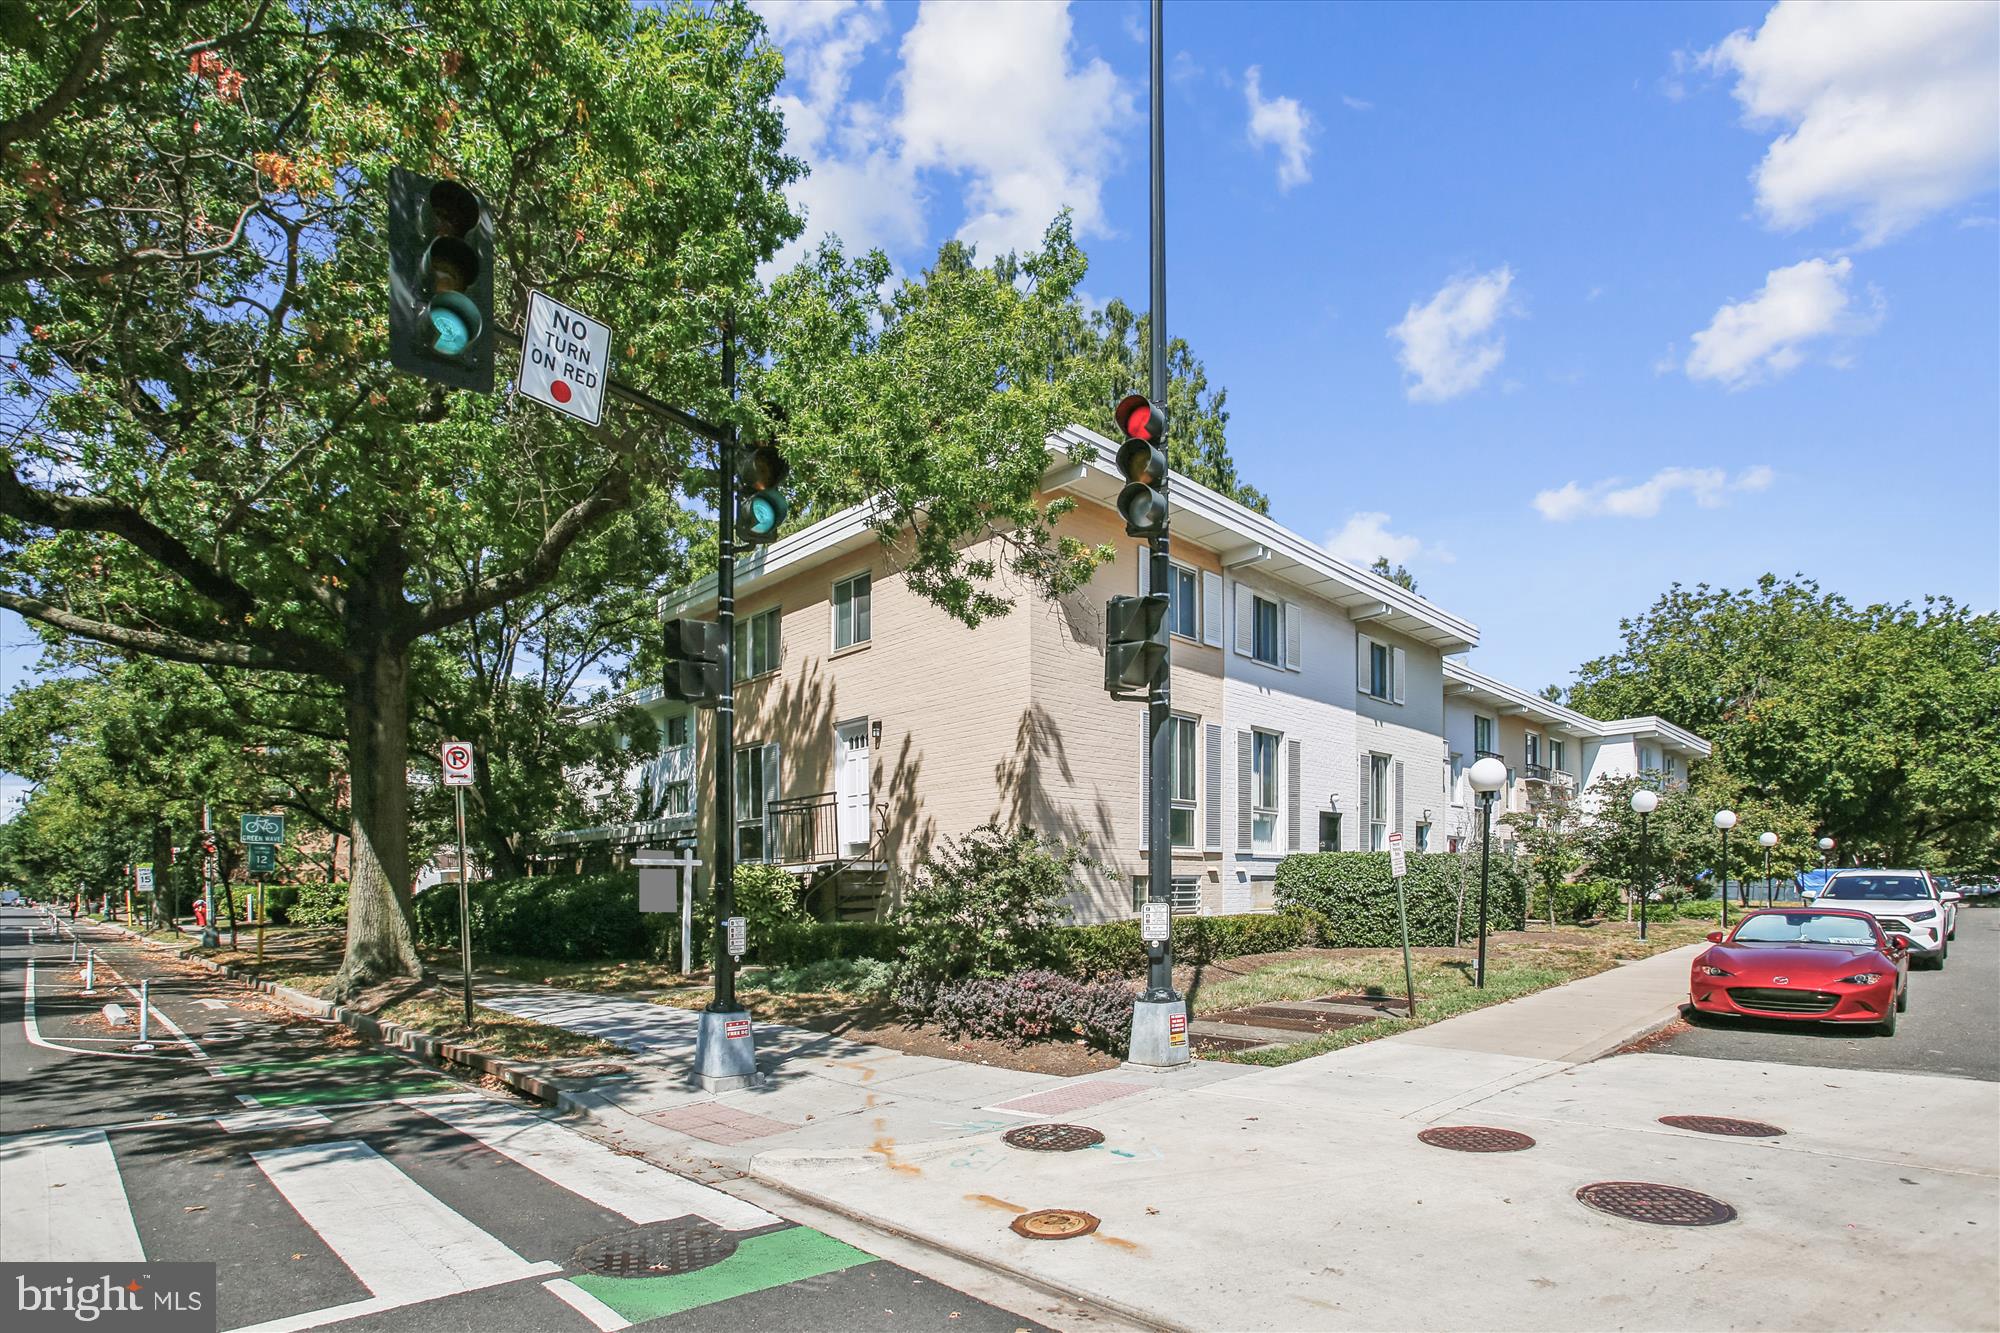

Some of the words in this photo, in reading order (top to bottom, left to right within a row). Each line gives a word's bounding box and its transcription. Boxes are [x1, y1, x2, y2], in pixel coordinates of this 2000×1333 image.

[553, 310, 587, 340] NO
[545, 331, 591, 365] TURN
[531, 348, 556, 371] ON
[563, 362, 597, 388] RED
[256, 855, 268, 864] 12
